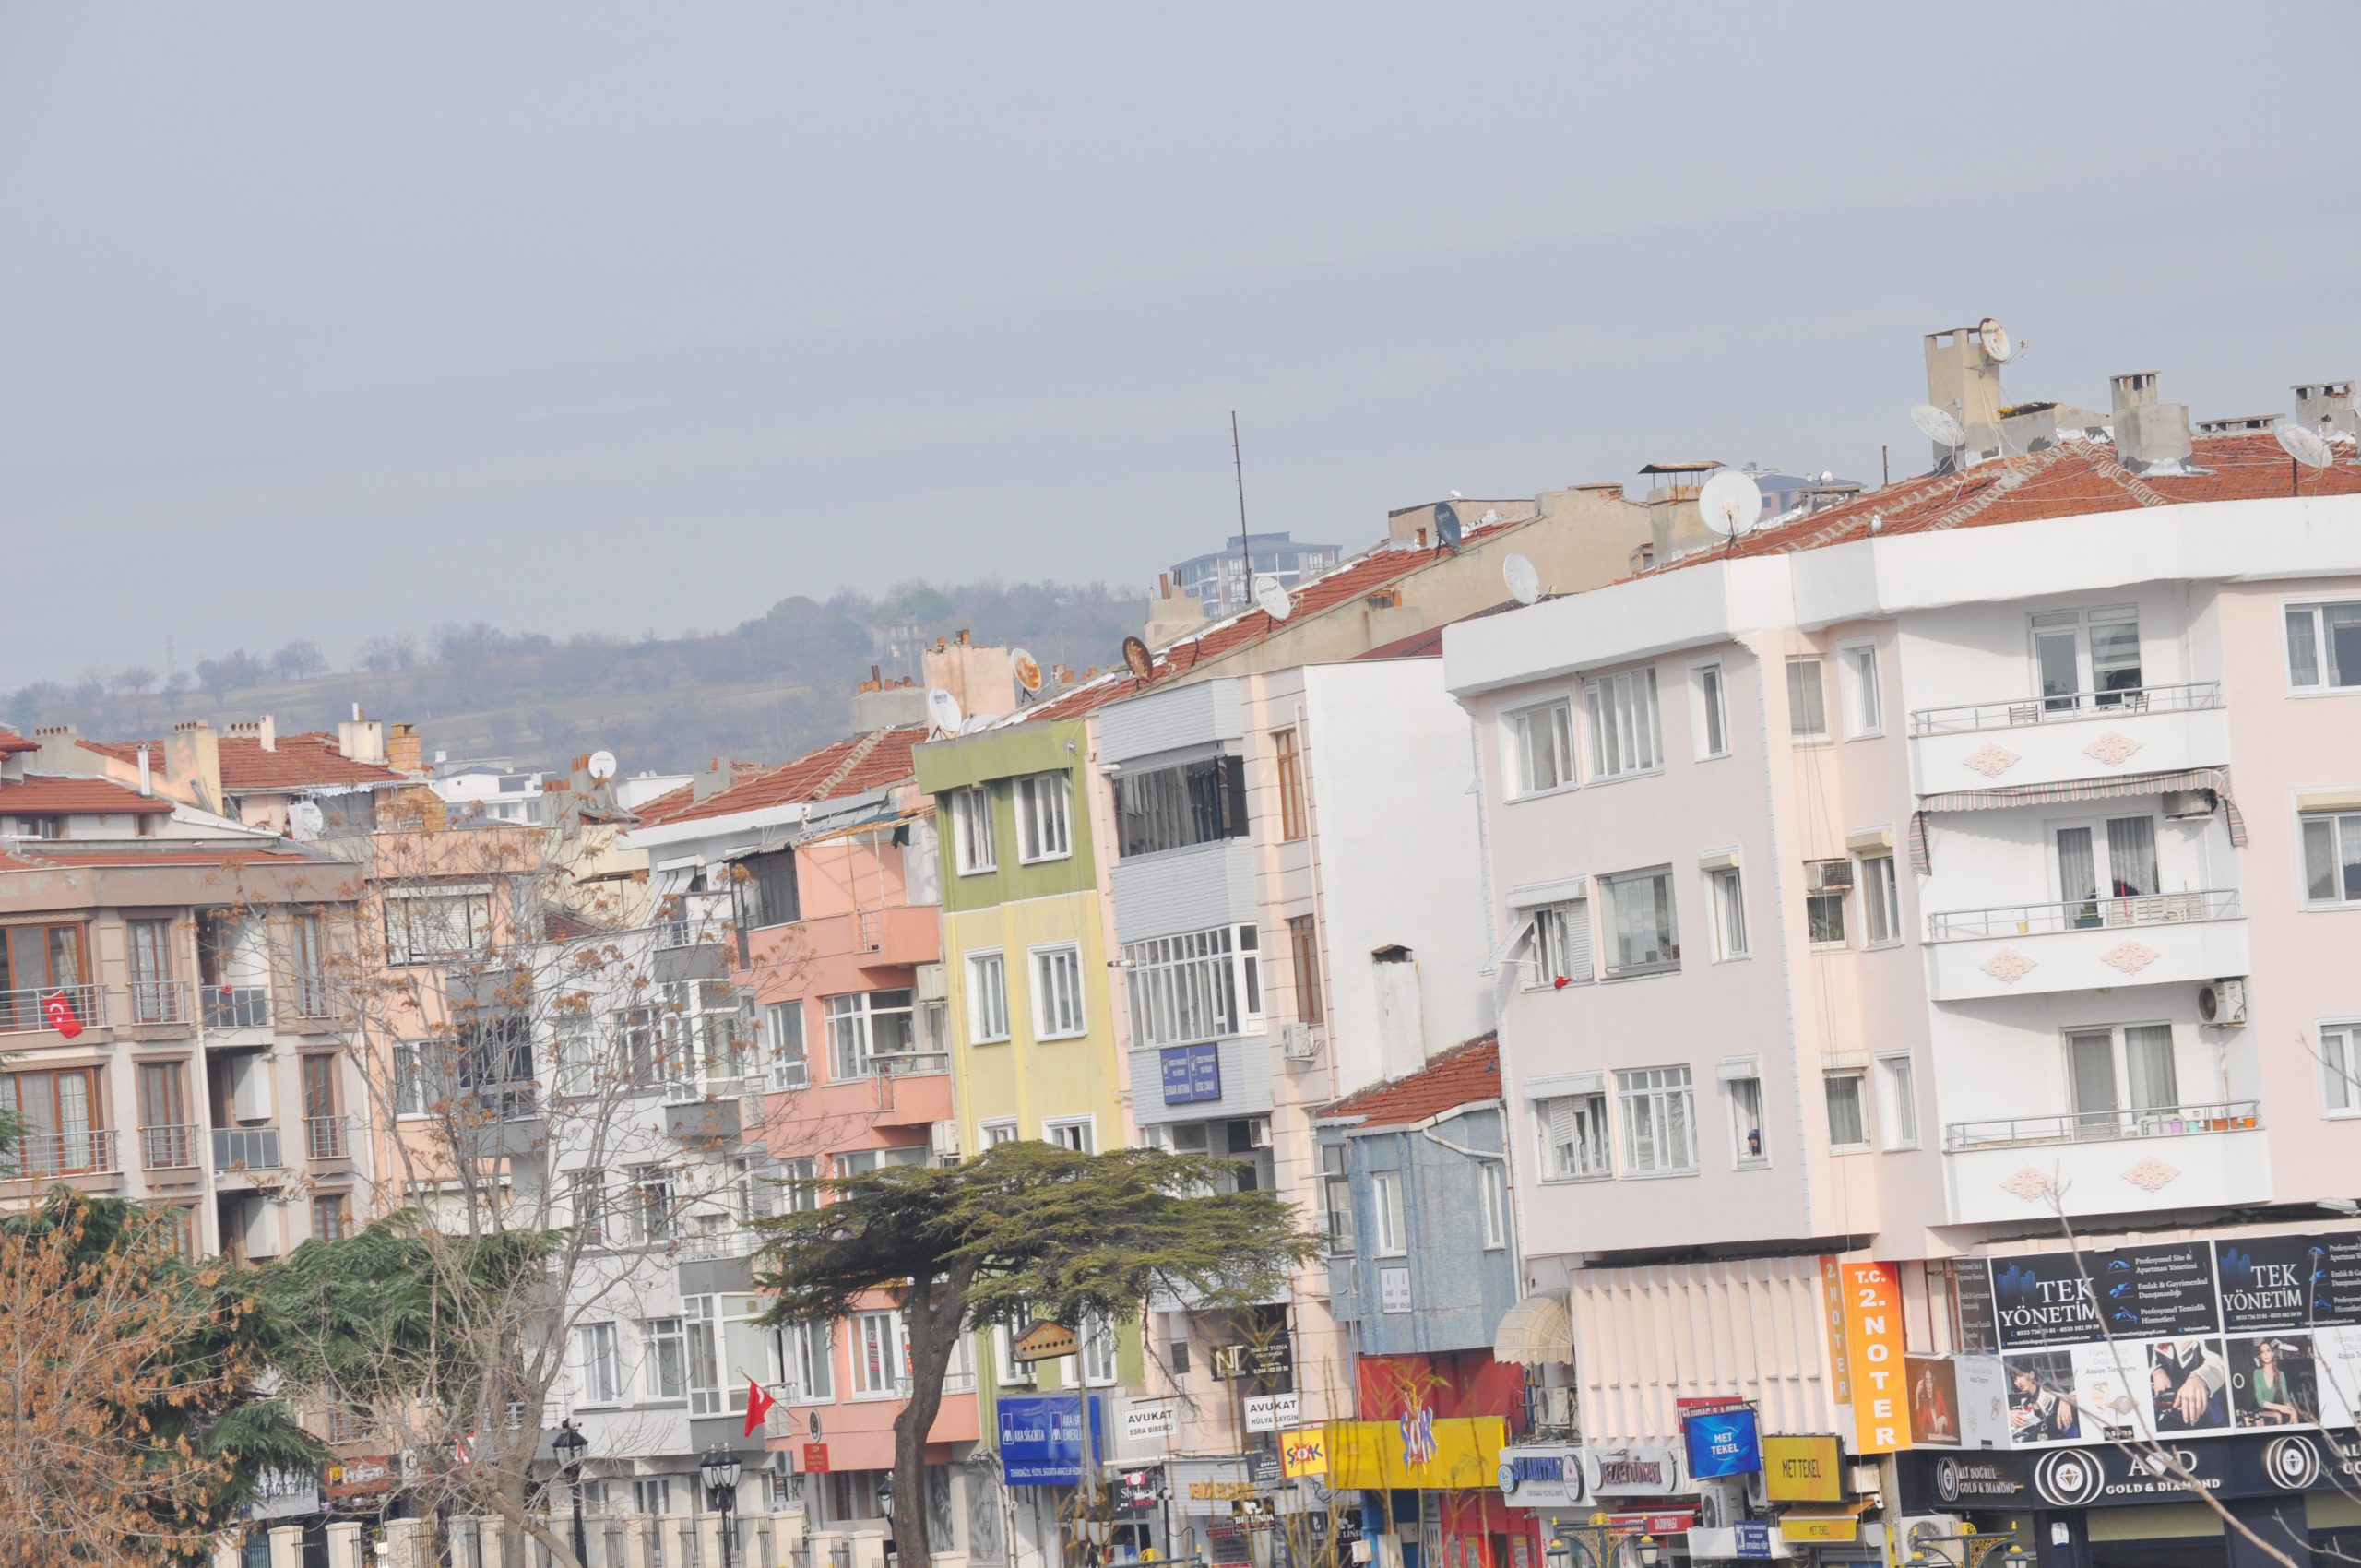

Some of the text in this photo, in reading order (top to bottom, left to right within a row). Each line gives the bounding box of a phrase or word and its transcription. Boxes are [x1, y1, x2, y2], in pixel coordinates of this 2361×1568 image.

[2134, 1254, 2172, 1266] Profesyonel
[2172, 1253, 2186, 1262] Site
[1825, 1262, 1836, 1278] 2.
[2135, 1262, 2198, 1276] Apartman Yönetimi
[2250, 1263, 2300, 1289] TEK
[1854, 1270, 1887, 1285] T.C.
[2137, 1277, 2209, 1290] Emlak & Gayrimenkul
[2035, 1277, 2098, 1303] TEK
[2138, 1289, 2182, 1299] Danışmanlığı
[1858, 1289, 1886, 1308] 2.
[2222, 1287, 2303, 1311] YÖNETİM
[1999, 1301, 2100, 1327] YÖNETİM
[2140, 1303, 2207, 1316] Profesyonel Temizlik
[2141, 1315, 2176, 1324] Hizmetleri
[1828, 1286, 1848, 1396] NOTER
[1863, 1315, 1897, 1446] NOTER
[1250, 1400, 1297, 1413] AVUKAT
[1128, 1409, 1174, 1424] AVUKAT
[1251, 1416, 1274, 1426] HÜLYA
[1014, 1427, 1046, 1442] AXA SİGORTA
[1129, 1423, 1174, 1436] ESRA BİBERCİ
[1399, 1406, 1439, 1477] ŞOK
[1714, 1431, 1734, 1444] MET
[1286, 1443, 1323, 1469] ŞOK
[1711, 1443, 1740, 1455] TEKEL
[1781, 1458, 1822, 1479] MET TEKEL
[1959, 1482, 1978, 1494] GOLD
[1986, 1481, 2016, 1494] DIAMOND
[2106, 1479, 2221, 1495] GOLD & DIAMND
